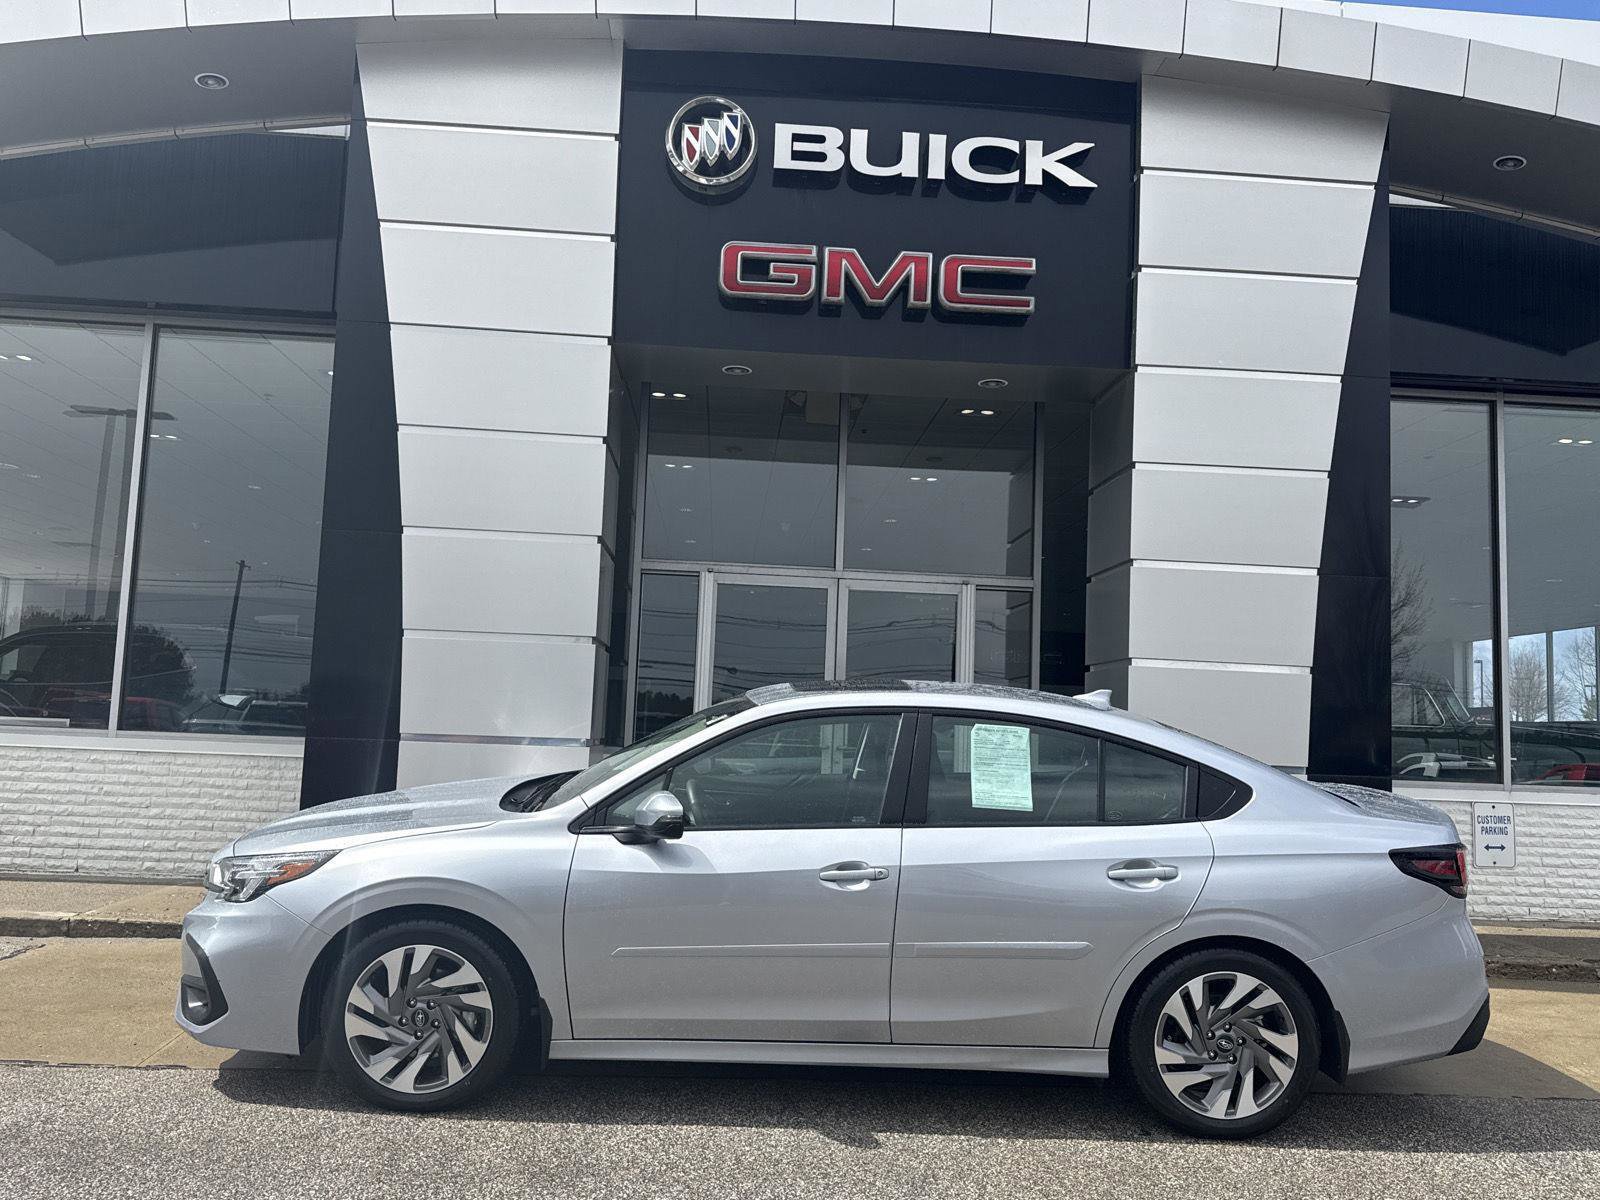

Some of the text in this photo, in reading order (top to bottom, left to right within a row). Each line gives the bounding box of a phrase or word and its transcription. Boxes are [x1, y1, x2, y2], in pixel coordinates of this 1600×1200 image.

[773, 122, 1098, 188] BUICK
[718, 240, 1036, 314] GMC
[1477, 815, 1511, 824] CUSTOMER
[1481, 826, 1509, 835] PARKING
